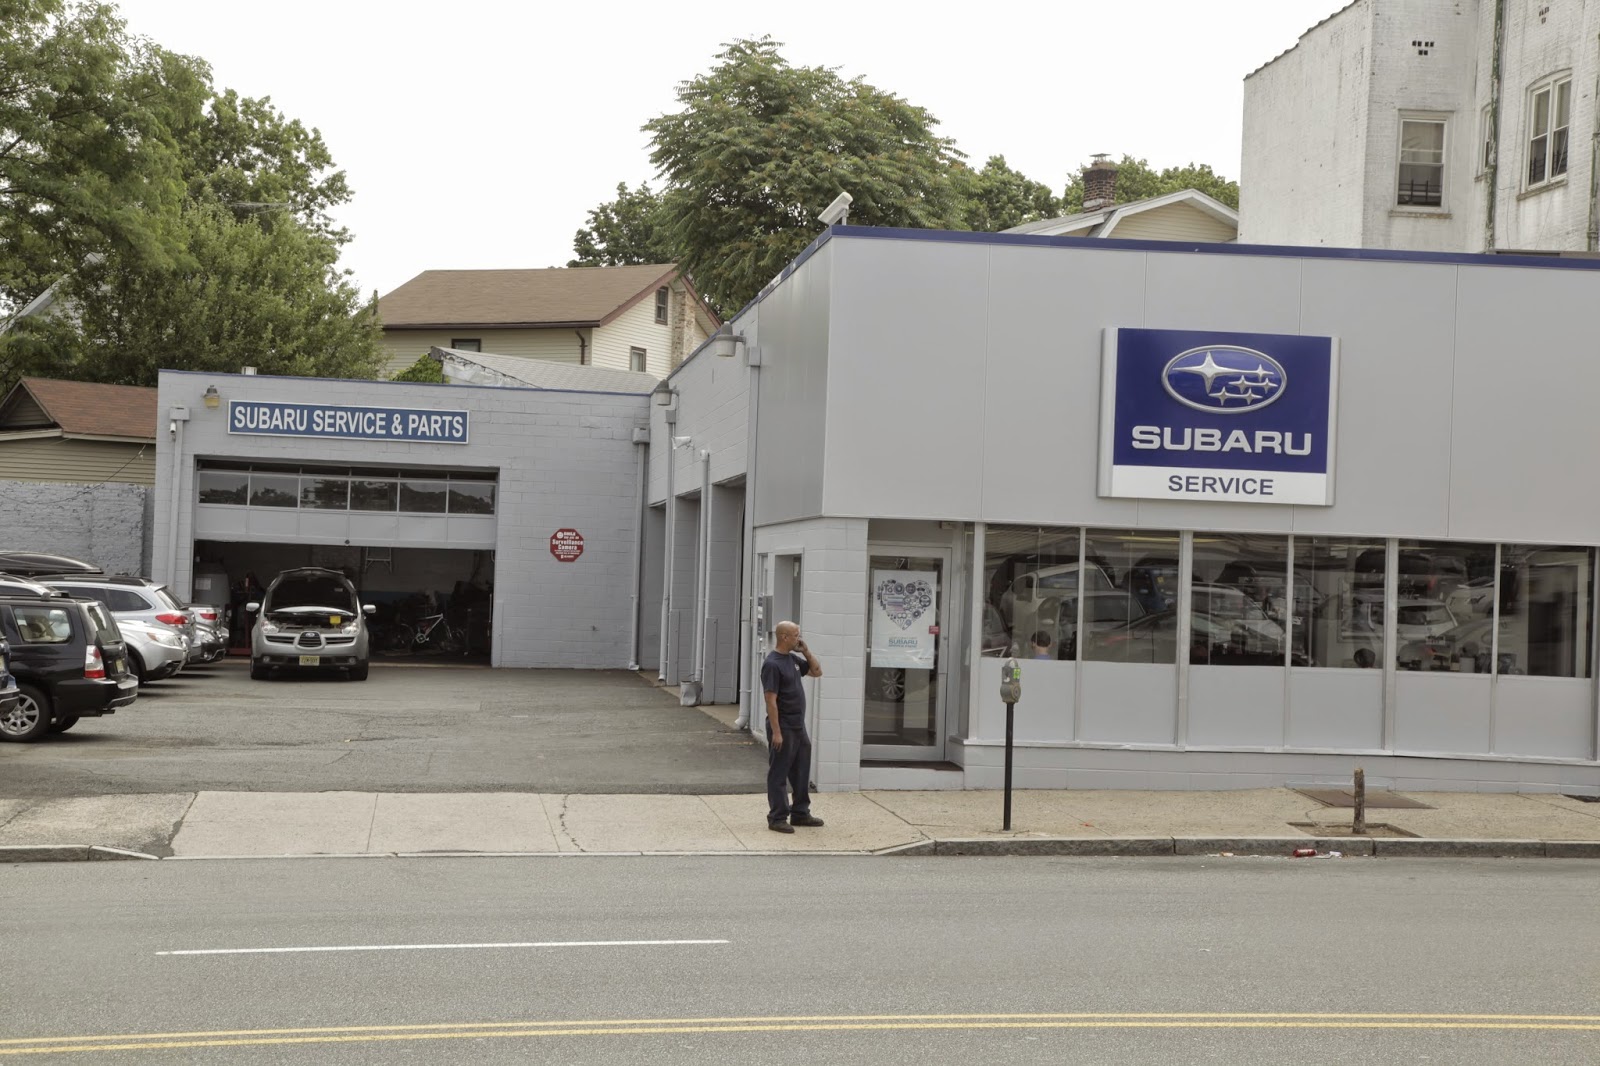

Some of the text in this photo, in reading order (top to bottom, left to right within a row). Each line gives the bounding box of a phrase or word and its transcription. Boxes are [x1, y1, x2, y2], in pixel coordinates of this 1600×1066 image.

[234, 405, 463, 438] SUBARU SERVICE & PARTS
[1131, 425, 1312, 456] SUBARU
[1168, 474, 1274, 496] SERVICE
